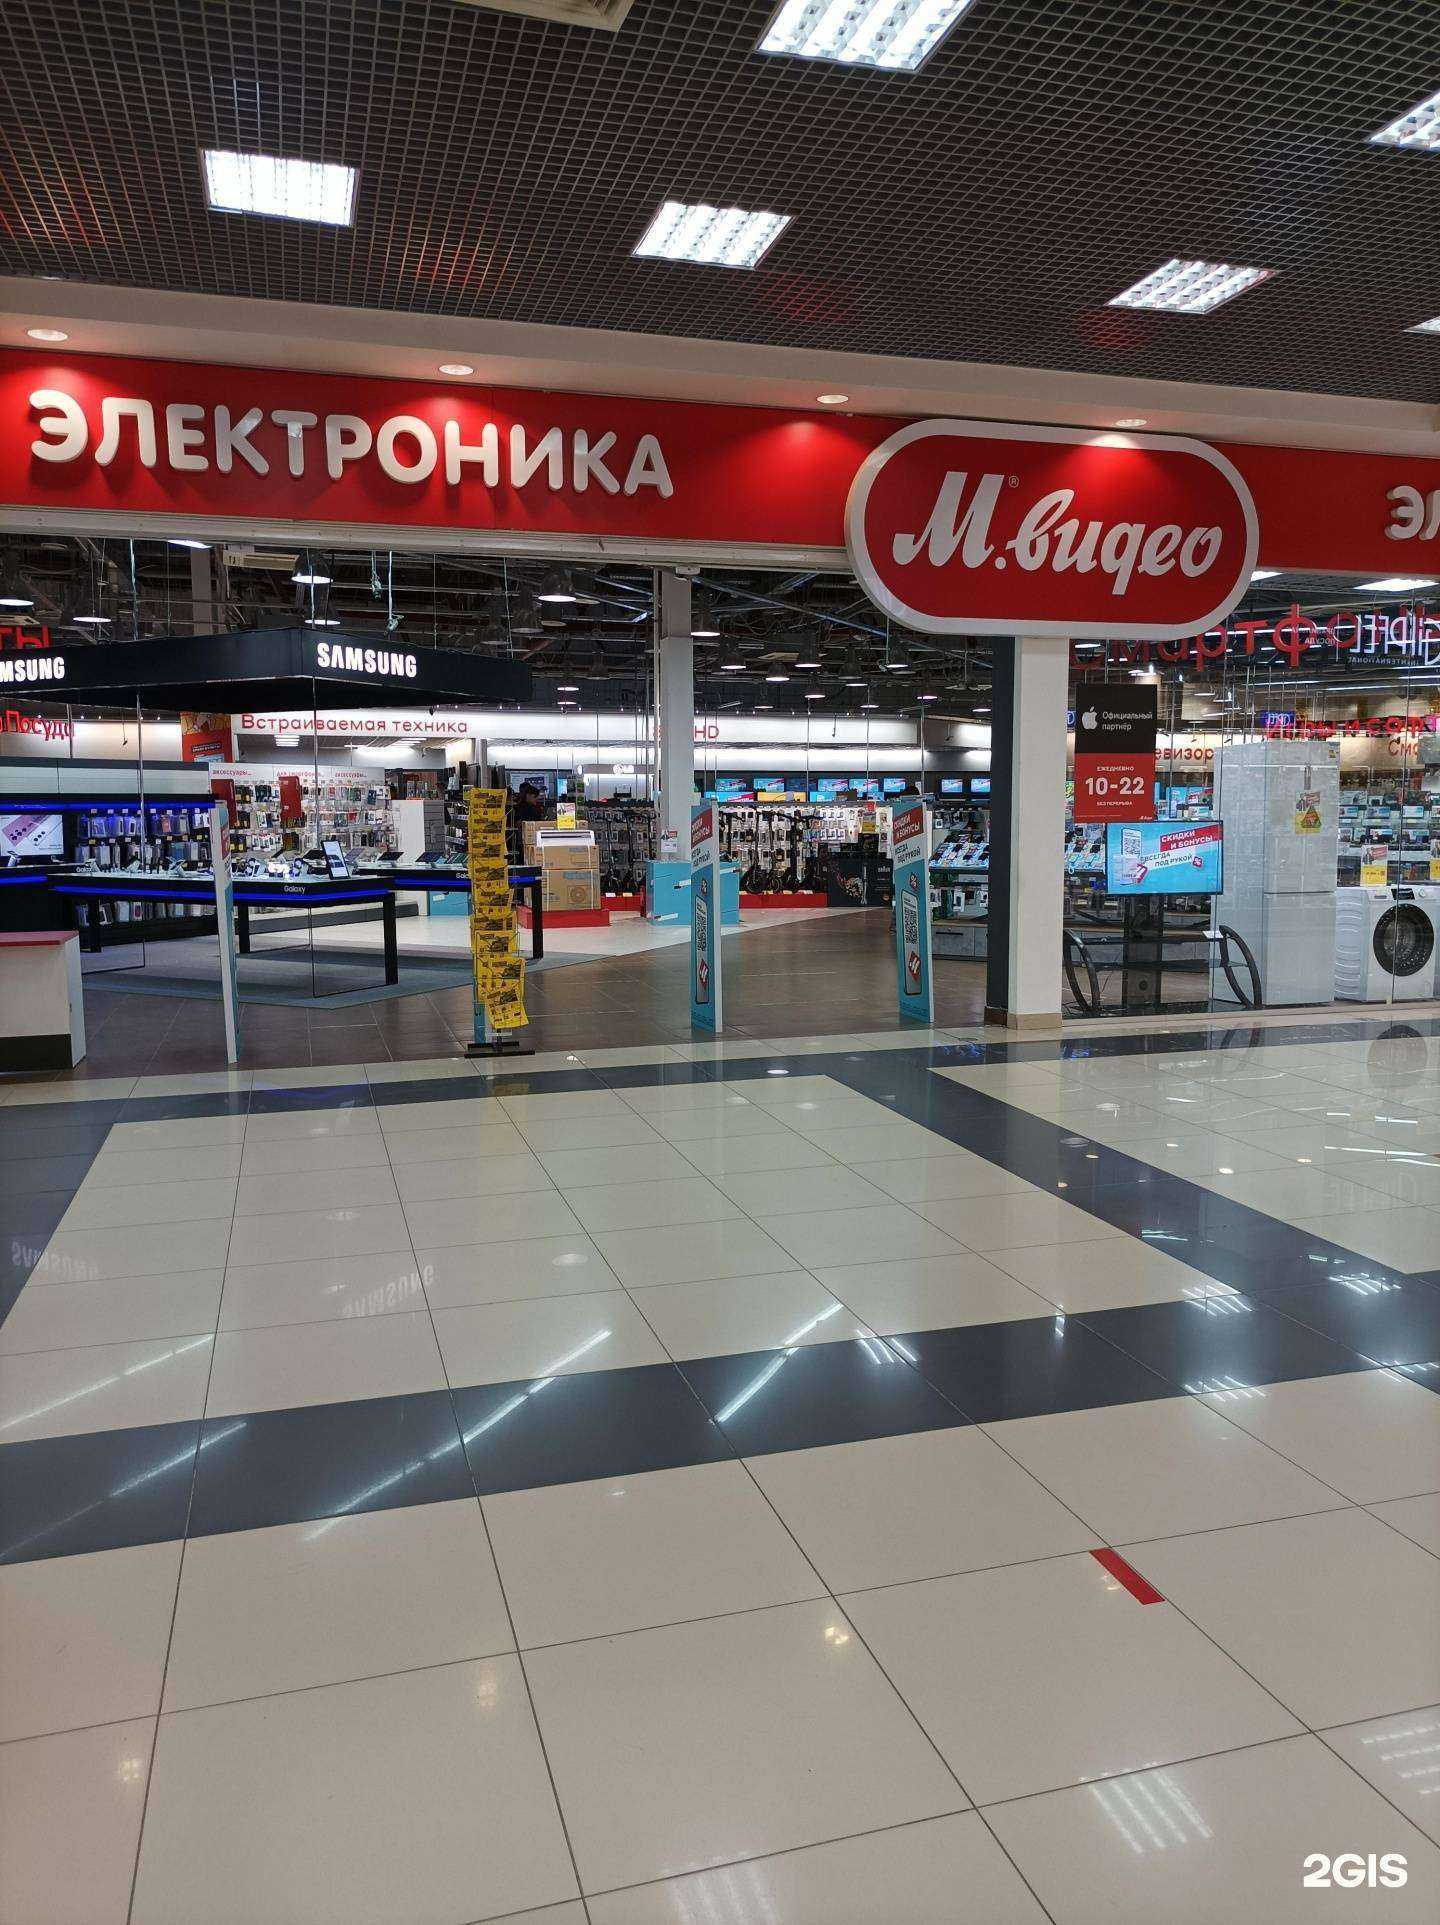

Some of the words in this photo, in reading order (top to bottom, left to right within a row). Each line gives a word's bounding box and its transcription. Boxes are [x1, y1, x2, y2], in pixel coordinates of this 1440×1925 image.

[29, 389, 674, 498] ЭЛЕКТРОНИКА
[317, 642, 417, 678] SAMSUNG
[241, 714, 386, 733] Встраиваемая
[392, 719, 467, 733] техника
[1102, 711, 1153, 721] Официальный
[1085, 776, 1145, 796] 10-22
[1161, 830, 1195, 844] СКИДКИ
[1170, 841, 1177, 850] И
[1178, 834, 1213, 849] БОНУСЫ
[283, 885, 306, 894] Galaxy
